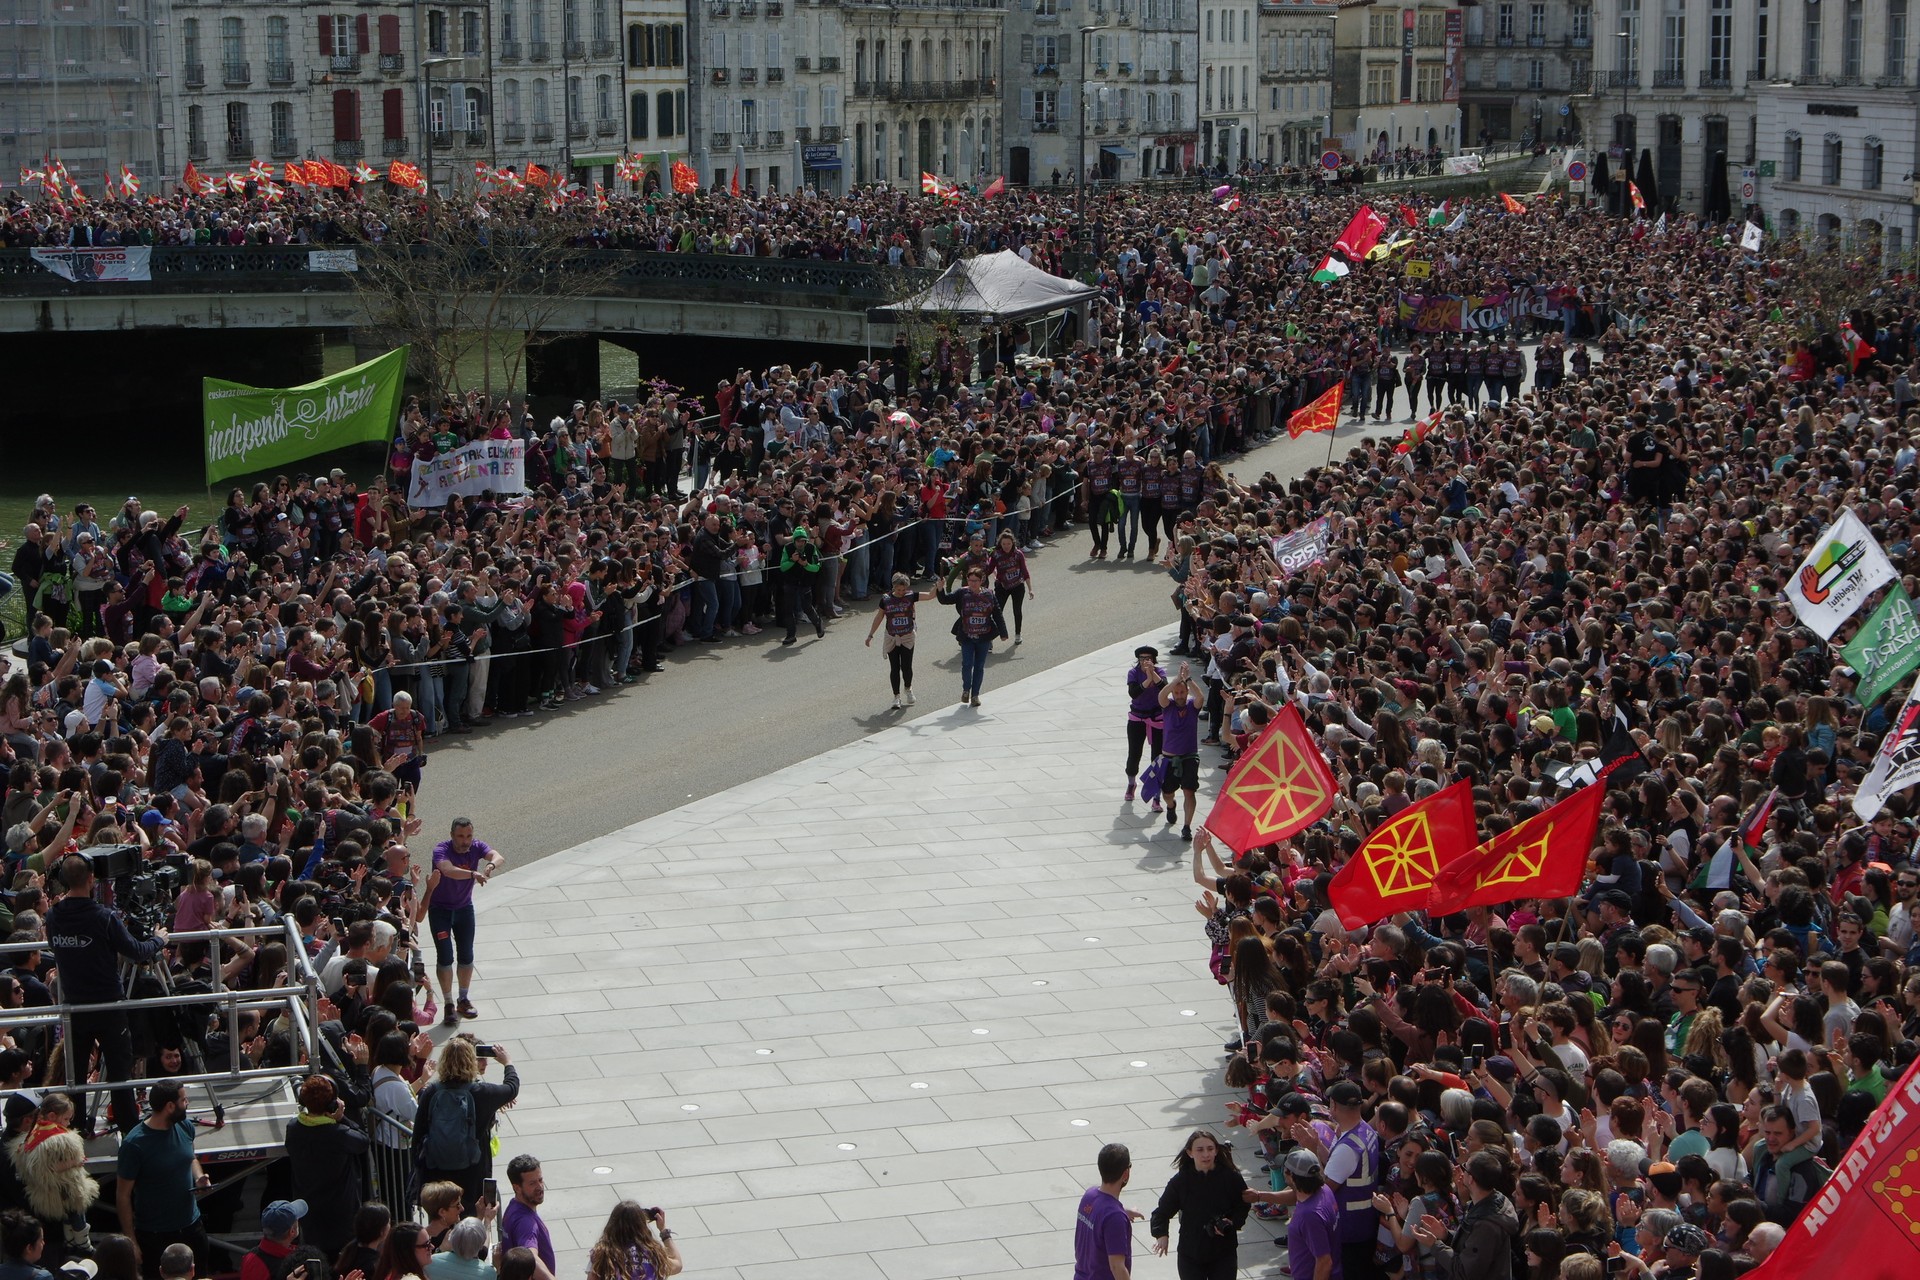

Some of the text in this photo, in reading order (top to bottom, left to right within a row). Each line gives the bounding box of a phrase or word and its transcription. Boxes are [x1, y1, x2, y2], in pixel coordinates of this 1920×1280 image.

[208, 388, 236, 400] euskaraz
[52, 934, 78, 947] pixel
[217, 1149, 259, 1160] SPAN
